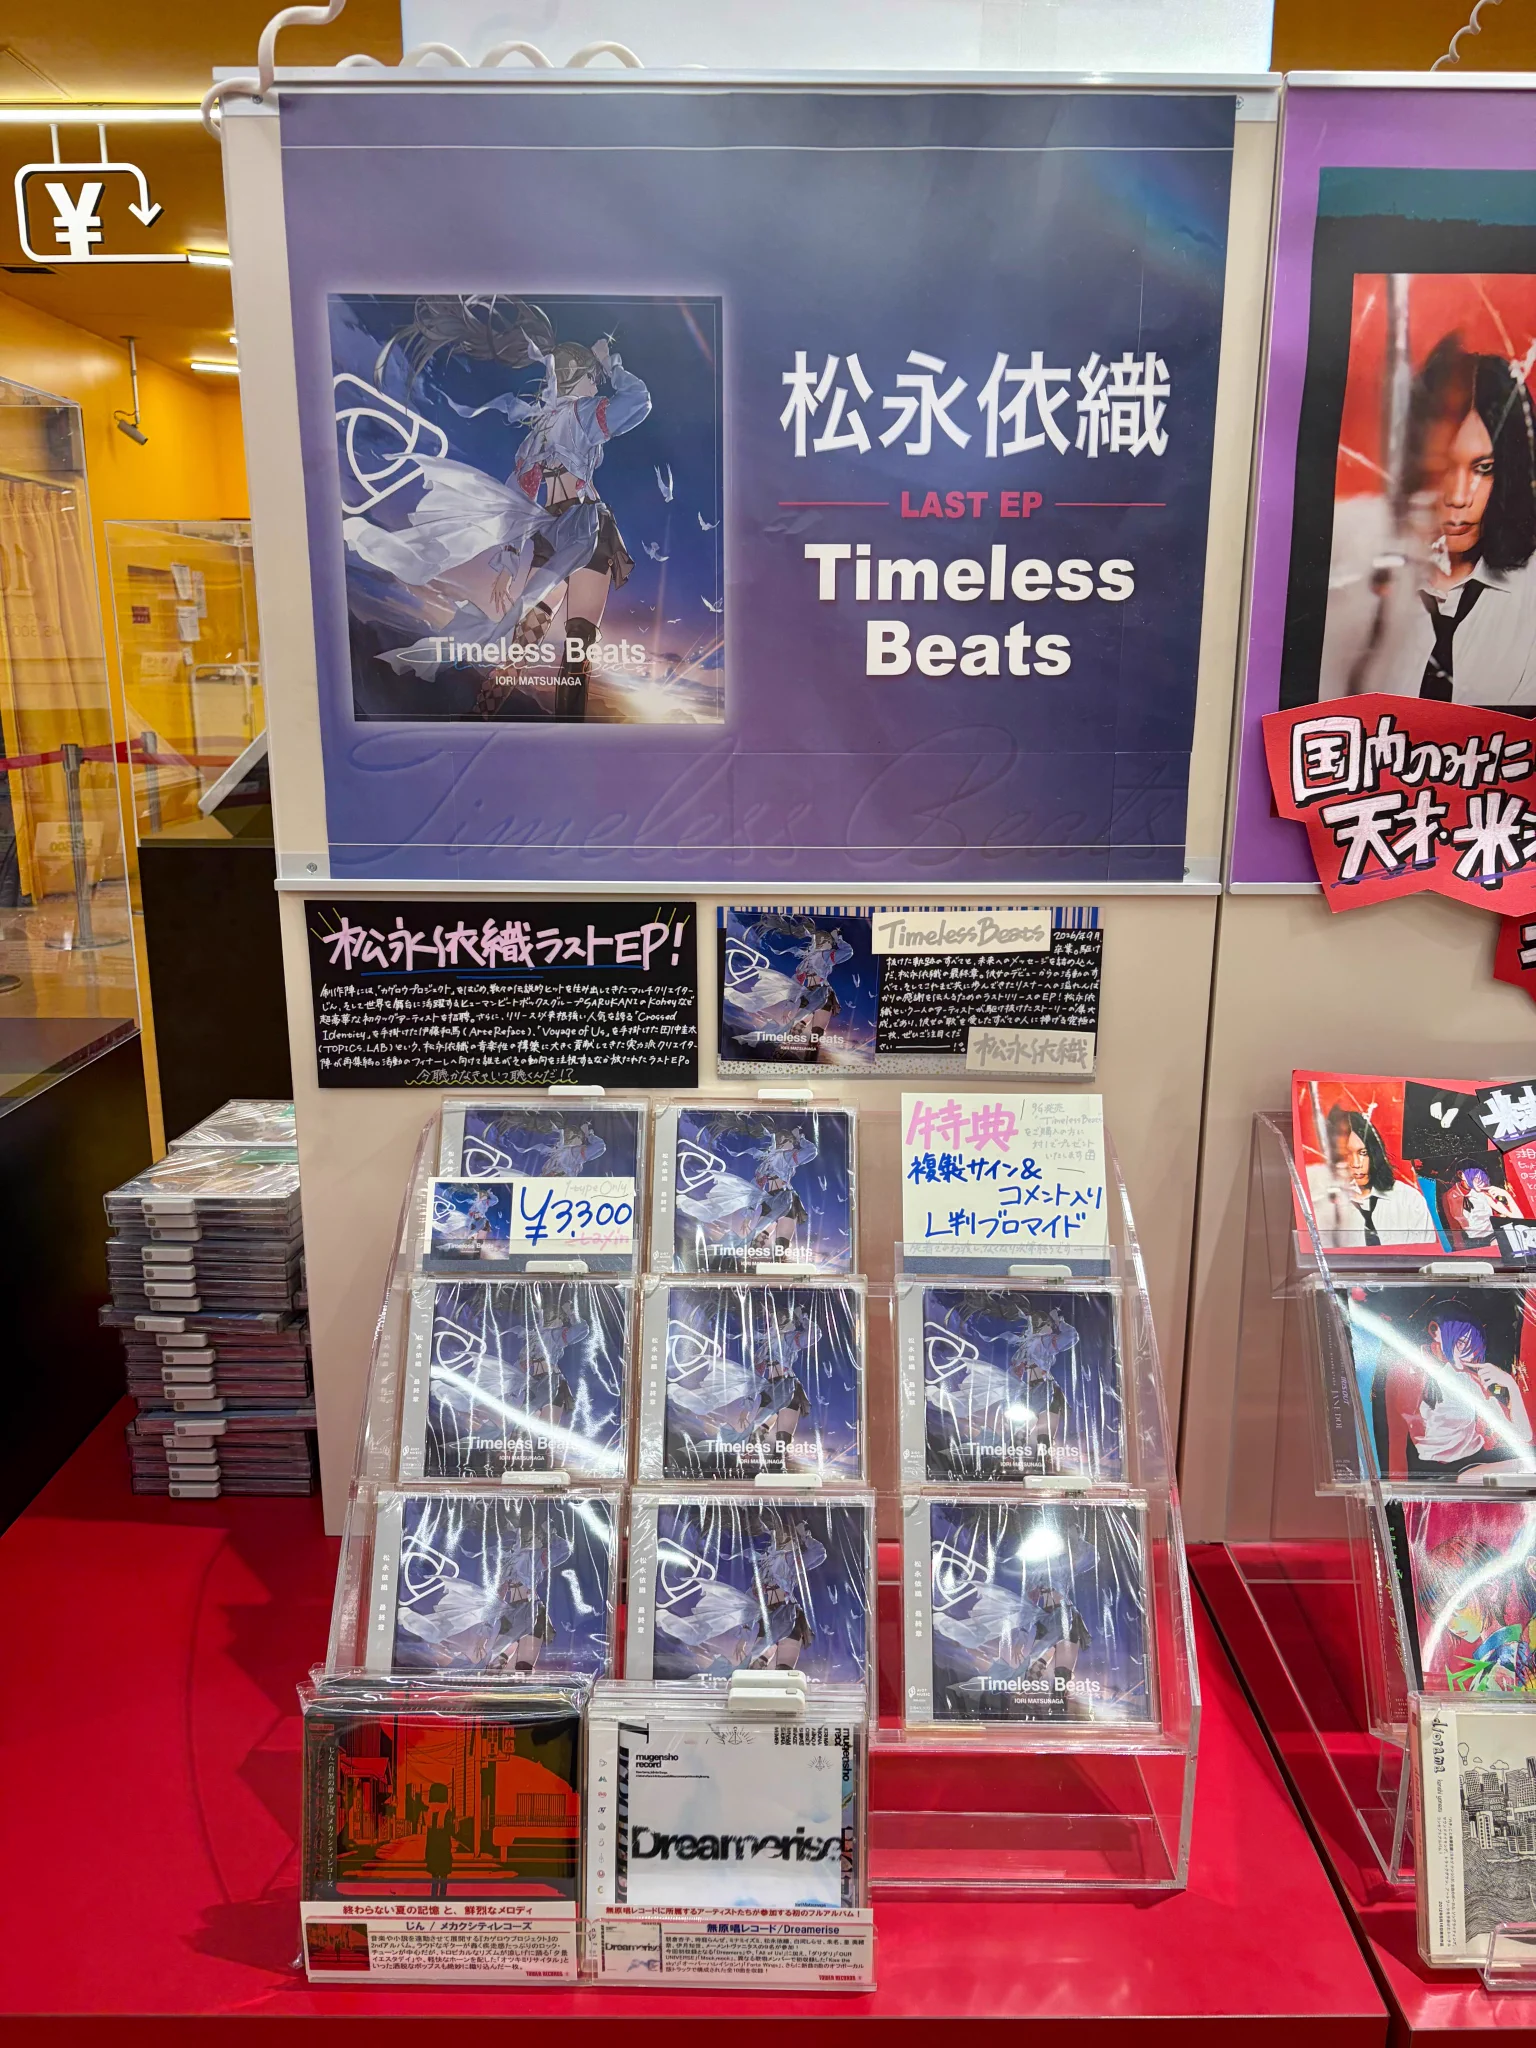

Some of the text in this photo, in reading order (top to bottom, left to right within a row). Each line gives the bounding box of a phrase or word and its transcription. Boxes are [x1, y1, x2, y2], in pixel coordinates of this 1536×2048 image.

[780, 349, 1170, 461] 松永依織
[900, 491, 1043, 519] LAST EP
[804, 542, 1136, 602] Timeless
[428, 635, 647, 666] Timeless Beats
[865, 620, 1073, 679] Beats
[494, 676, 582, 687] IORI MATSUNAGA
[1290, 714, 1532, 807] 国内のみに
[1319, 787, 1536, 892] 天才・米
[755, 1031, 844, 1044] Timeless Beats
[973, 1032, 1088, 1069] 松永依織
[905, 1099, 1019, 1152] 特典
[448, 1151, 456, 1178] 松永依
[907, 1152, 1043, 1185] 複製サイン&
[998, 1183, 1103, 1209] コメント入り
[924, 1208, 1087, 1239] L判ブロマイド
[711, 1244, 813, 1257] Timeless Beats
[650, 1337, 659, 1370] 松永依織
[466, 1436, 532, 1449] Timeless
[706, 1440, 817, 1453] Timeless Beats
[967, 1442, 1079, 1457] Timeless Beats
[377, 1554, 391, 1632] 松永依織 最終章
[637, 1557, 647, 1634] 松永依織 最終章
[914, 1560, 923, 1638] 松永依織 最終章
[978, 1676, 1100, 1692] Timeless Beats
[635, 1753, 679, 1762] mugensho
[842, 1728, 852, 1781] mugensho
[631, 1824, 843, 1862] Dreamerise
[342, 1905, 533, 1915] 終わらない夏の記憶 と、 鮮烈なメロディ
[405, 1921, 424, 1931] じん
[440, 1921, 533, 1931] メカクシティレコーズ
